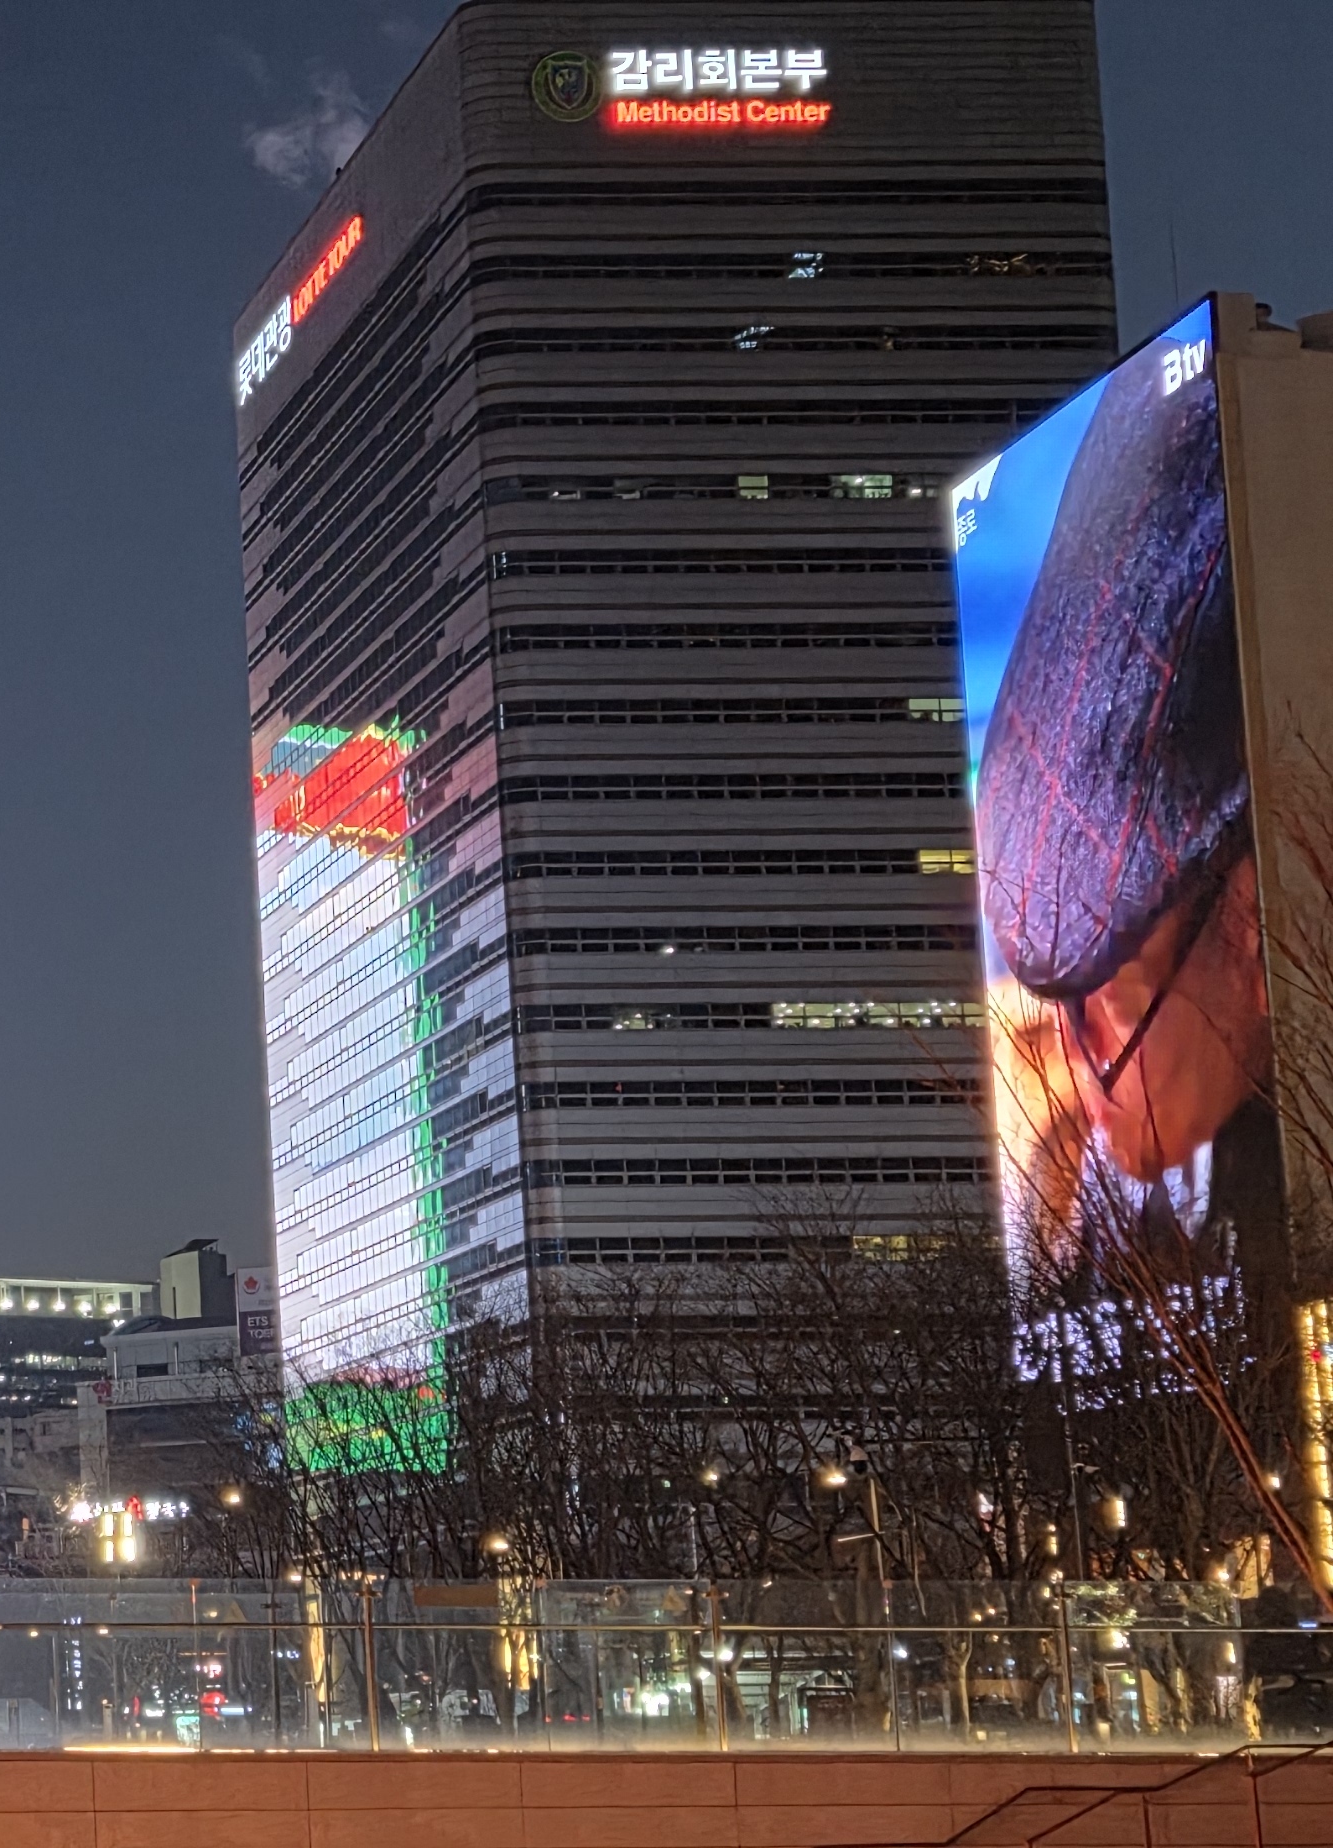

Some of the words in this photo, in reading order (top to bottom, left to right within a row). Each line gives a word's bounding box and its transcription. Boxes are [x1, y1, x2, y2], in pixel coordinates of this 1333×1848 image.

[611, 49, 828, 91] 감리회본부
[616, 100, 741, 123] Methodist
[746, 100, 831, 123] Center
[328, 214, 362, 276] TOUR
[238, 295, 293, 406] 롯데관광
[247, 1315, 269, 1328] ETS
